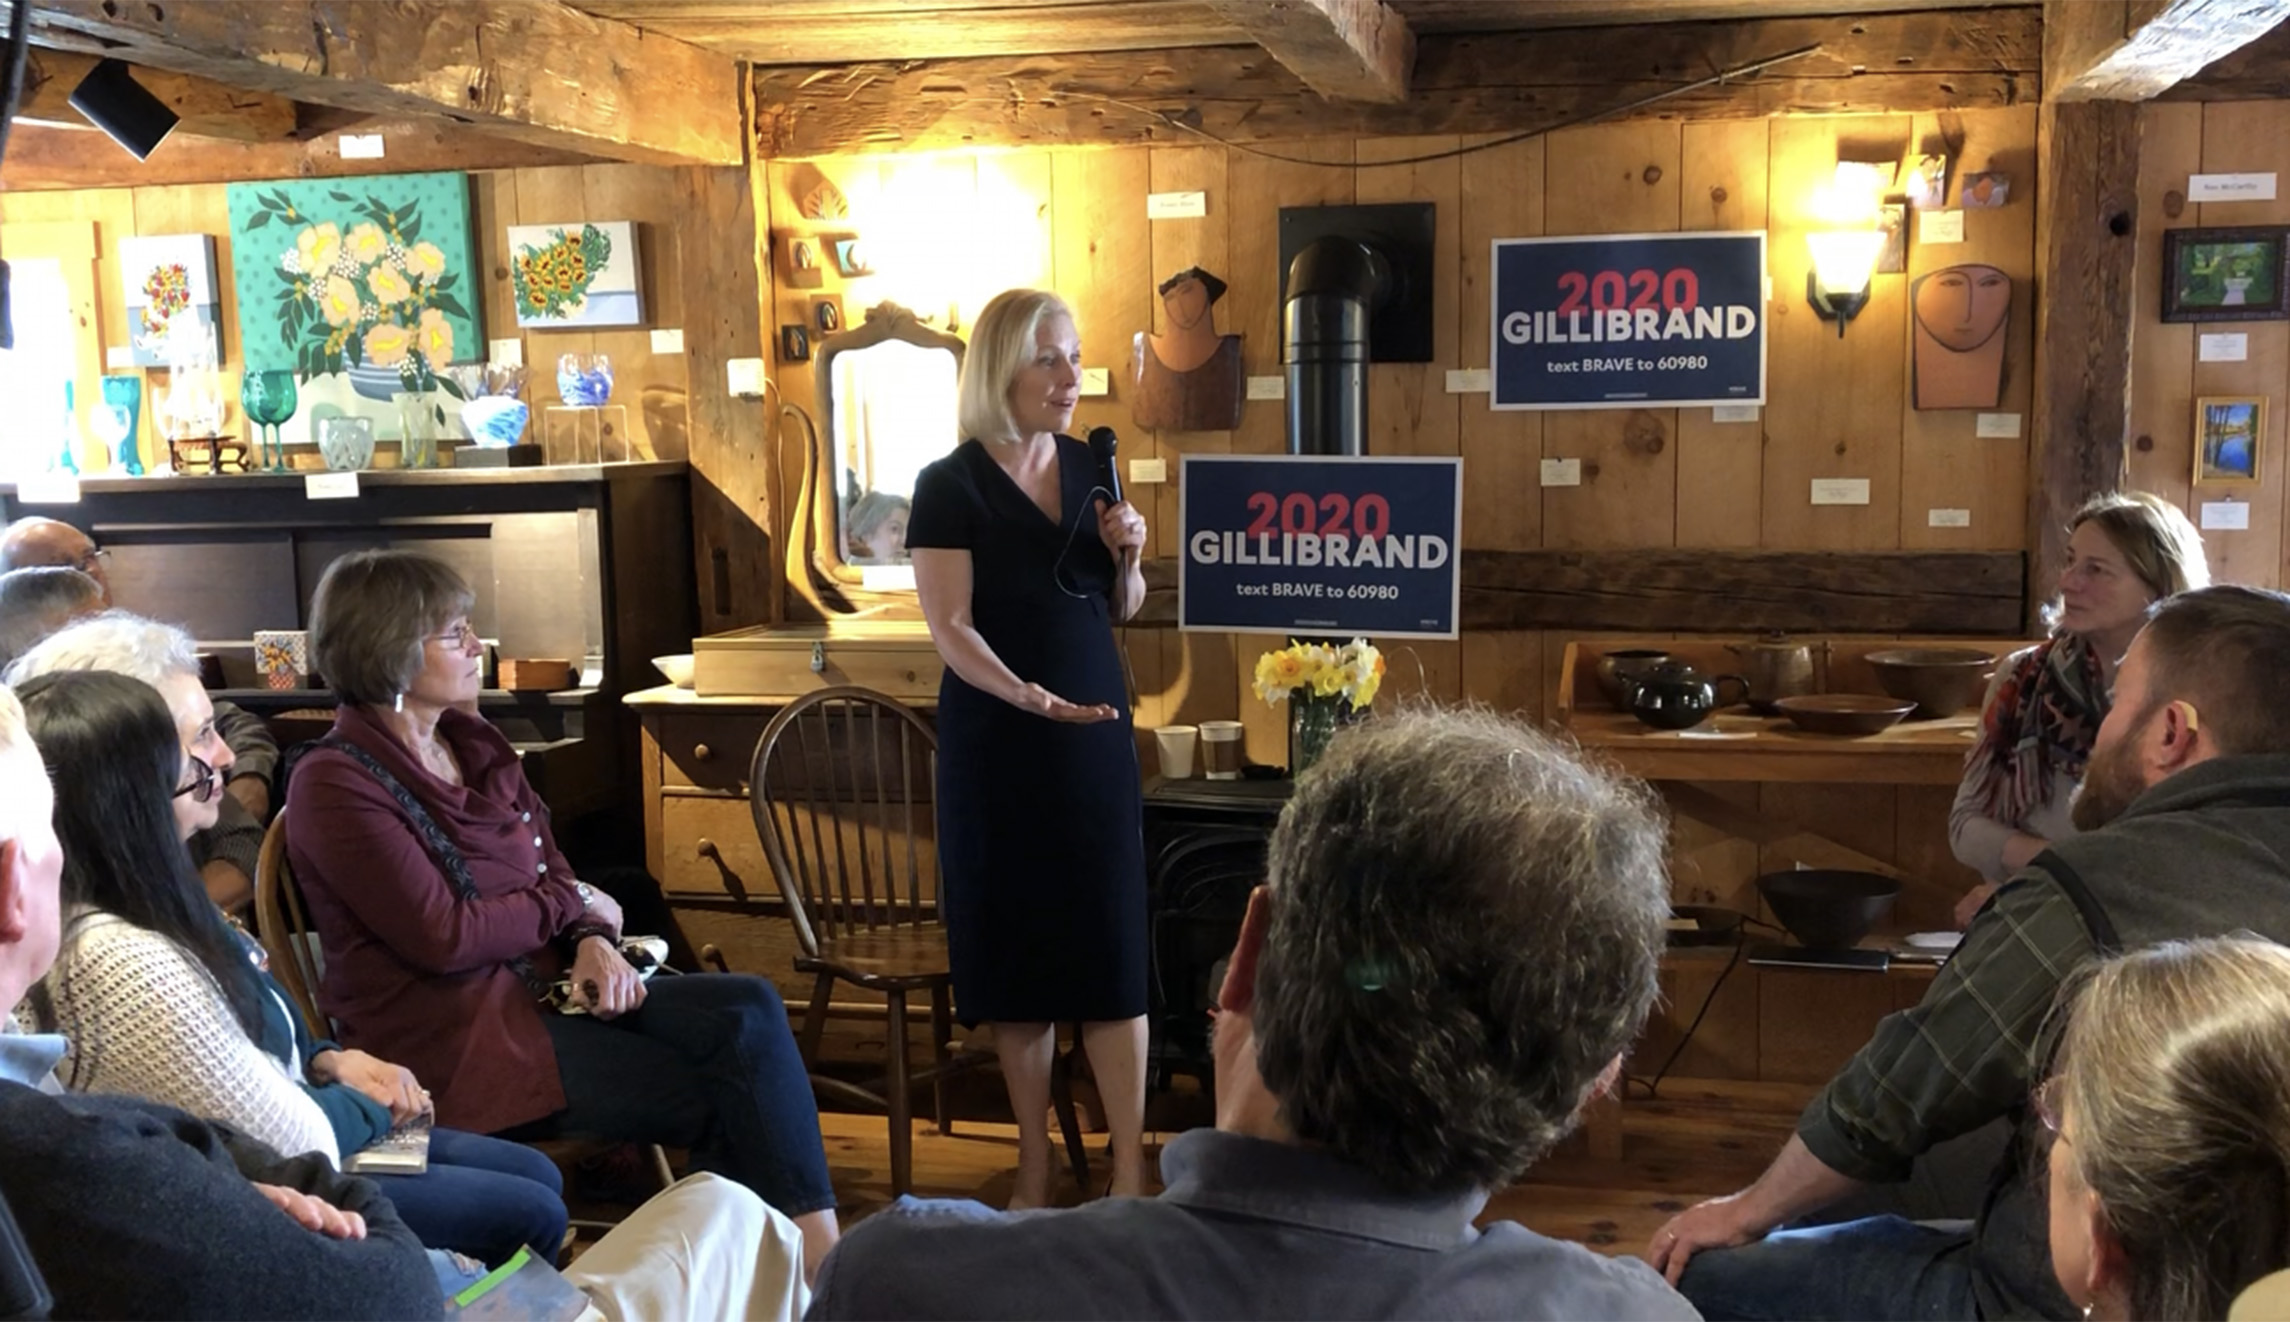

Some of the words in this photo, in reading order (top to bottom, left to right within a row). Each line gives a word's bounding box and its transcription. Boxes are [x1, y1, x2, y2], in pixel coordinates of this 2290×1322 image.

[1557, 267, 1699, 318] 2020
[1502, 305, 1756, 344] GILLIBRAND
[1547, 360, 1579, 373] text
[1582, 357, 1634, 372] BRAVE
[1637, 358, 1654, 371] to
[1657, 355, 1708, 371] 60980
[1247, 492, 1390, 542] 2020
[1190, 530, 1448, 569] GILLIBRAND
[1236, 583, 1269, 596] text
[1272, 583, 1323, 597] BRAVE
[1327, 585, 1344, 598] to
[1347, 585, 1399, 600] 60980
